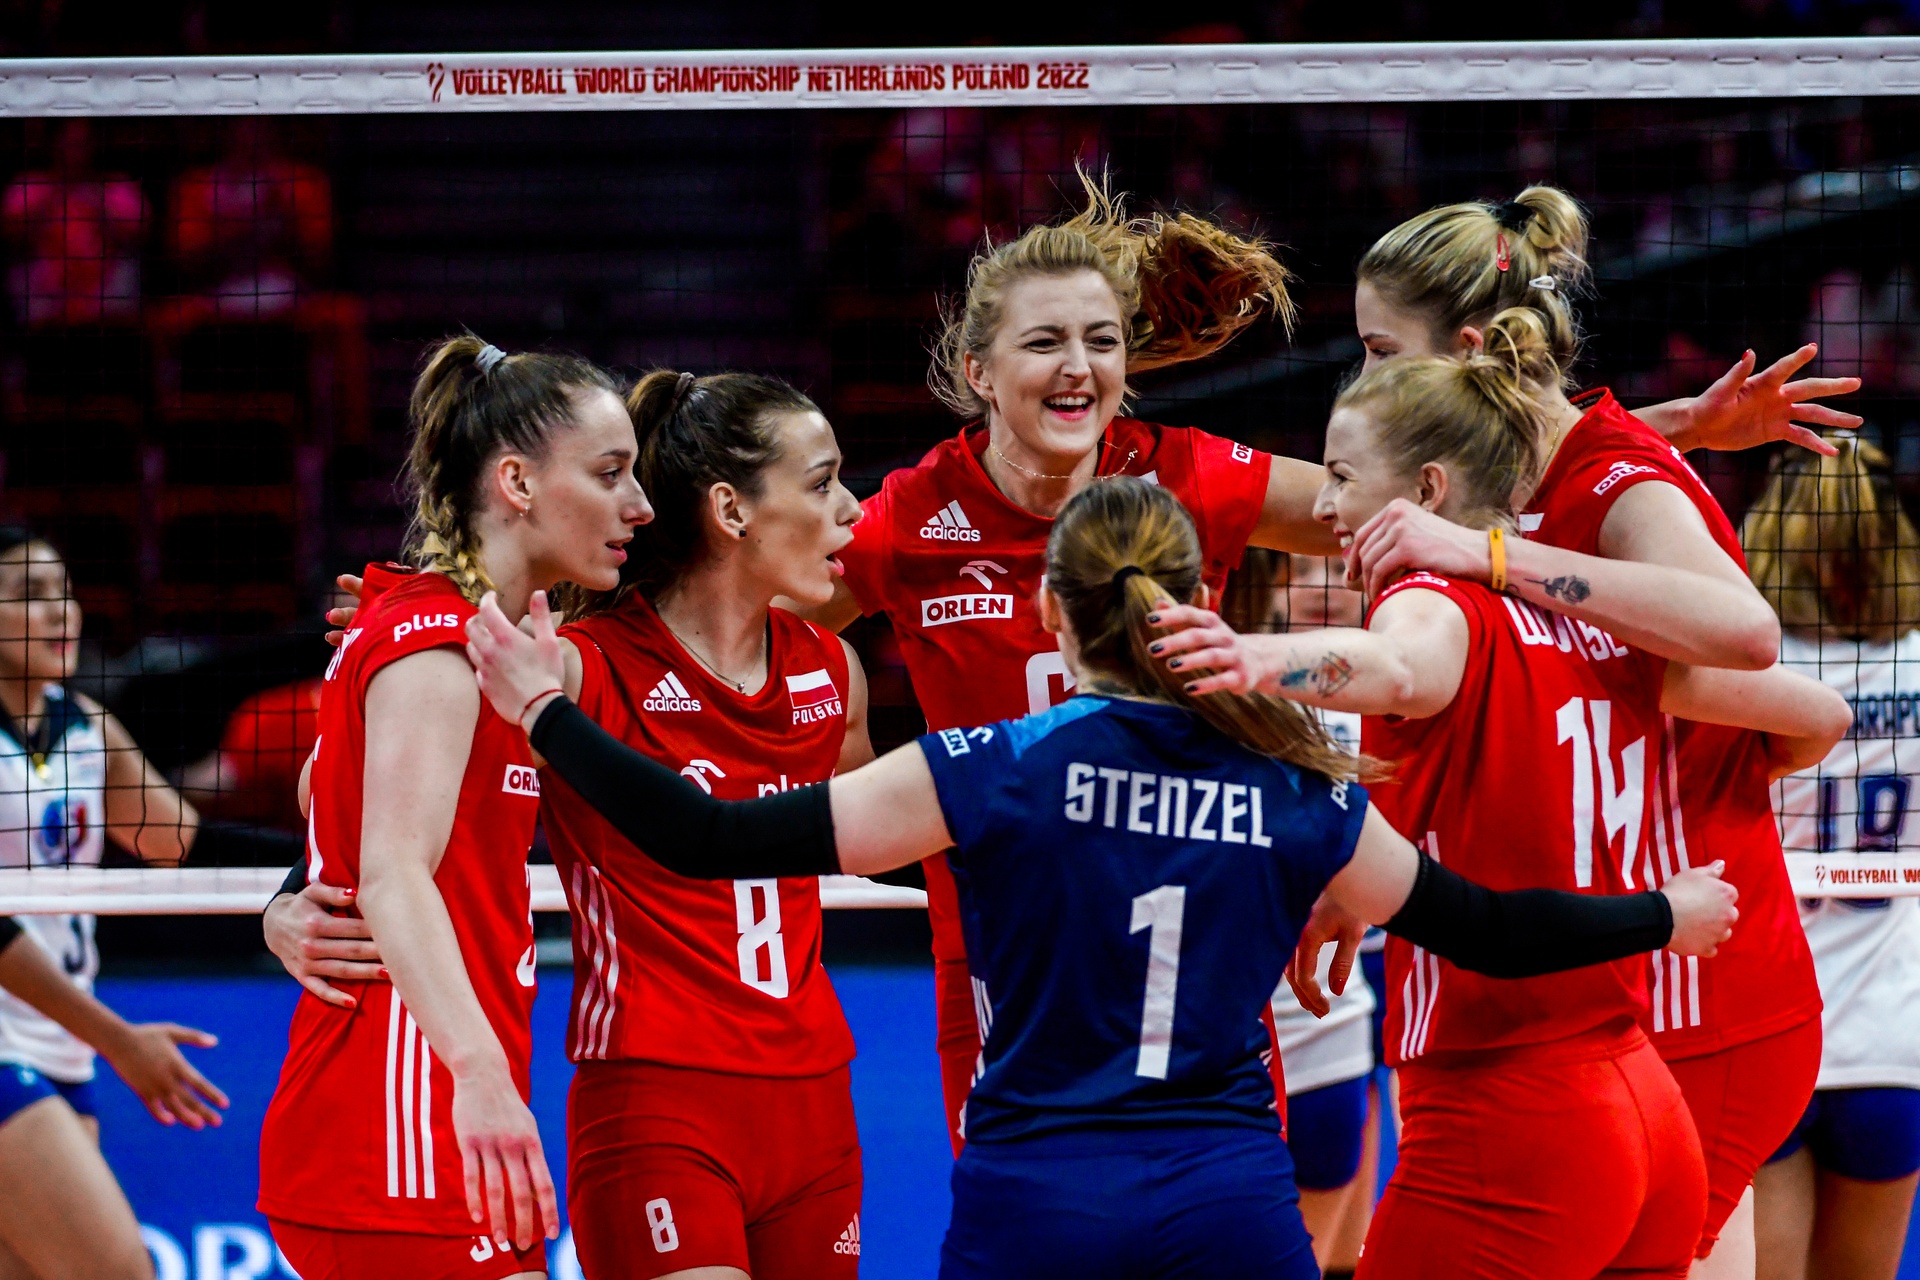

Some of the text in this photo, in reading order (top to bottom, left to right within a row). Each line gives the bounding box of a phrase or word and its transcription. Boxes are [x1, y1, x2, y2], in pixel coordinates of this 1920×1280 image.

[452, 62, 1090, 95] VOLLEYBALL WORLD CHAMPIONSHIP NETHERLANDS POLAND 2022
[919, 525, 982, 542] adidas
[926, 597, 1006, 622] ORLEN
[393, 613, 459, 643] plus
[643, 697, 702, 712] adidas
[792, 700, 843, 725] POLSKA
[1064, 762, 1273, 848] STENZEL
[1556, 697, 1646, 890] 14
[1830, 868, 1898, 884] VOLLEYBALL
[733, 879, 789, 999] 8
[1129, 885, 1186, 1080] 1
[645, 1197, 680, 1253] 8
